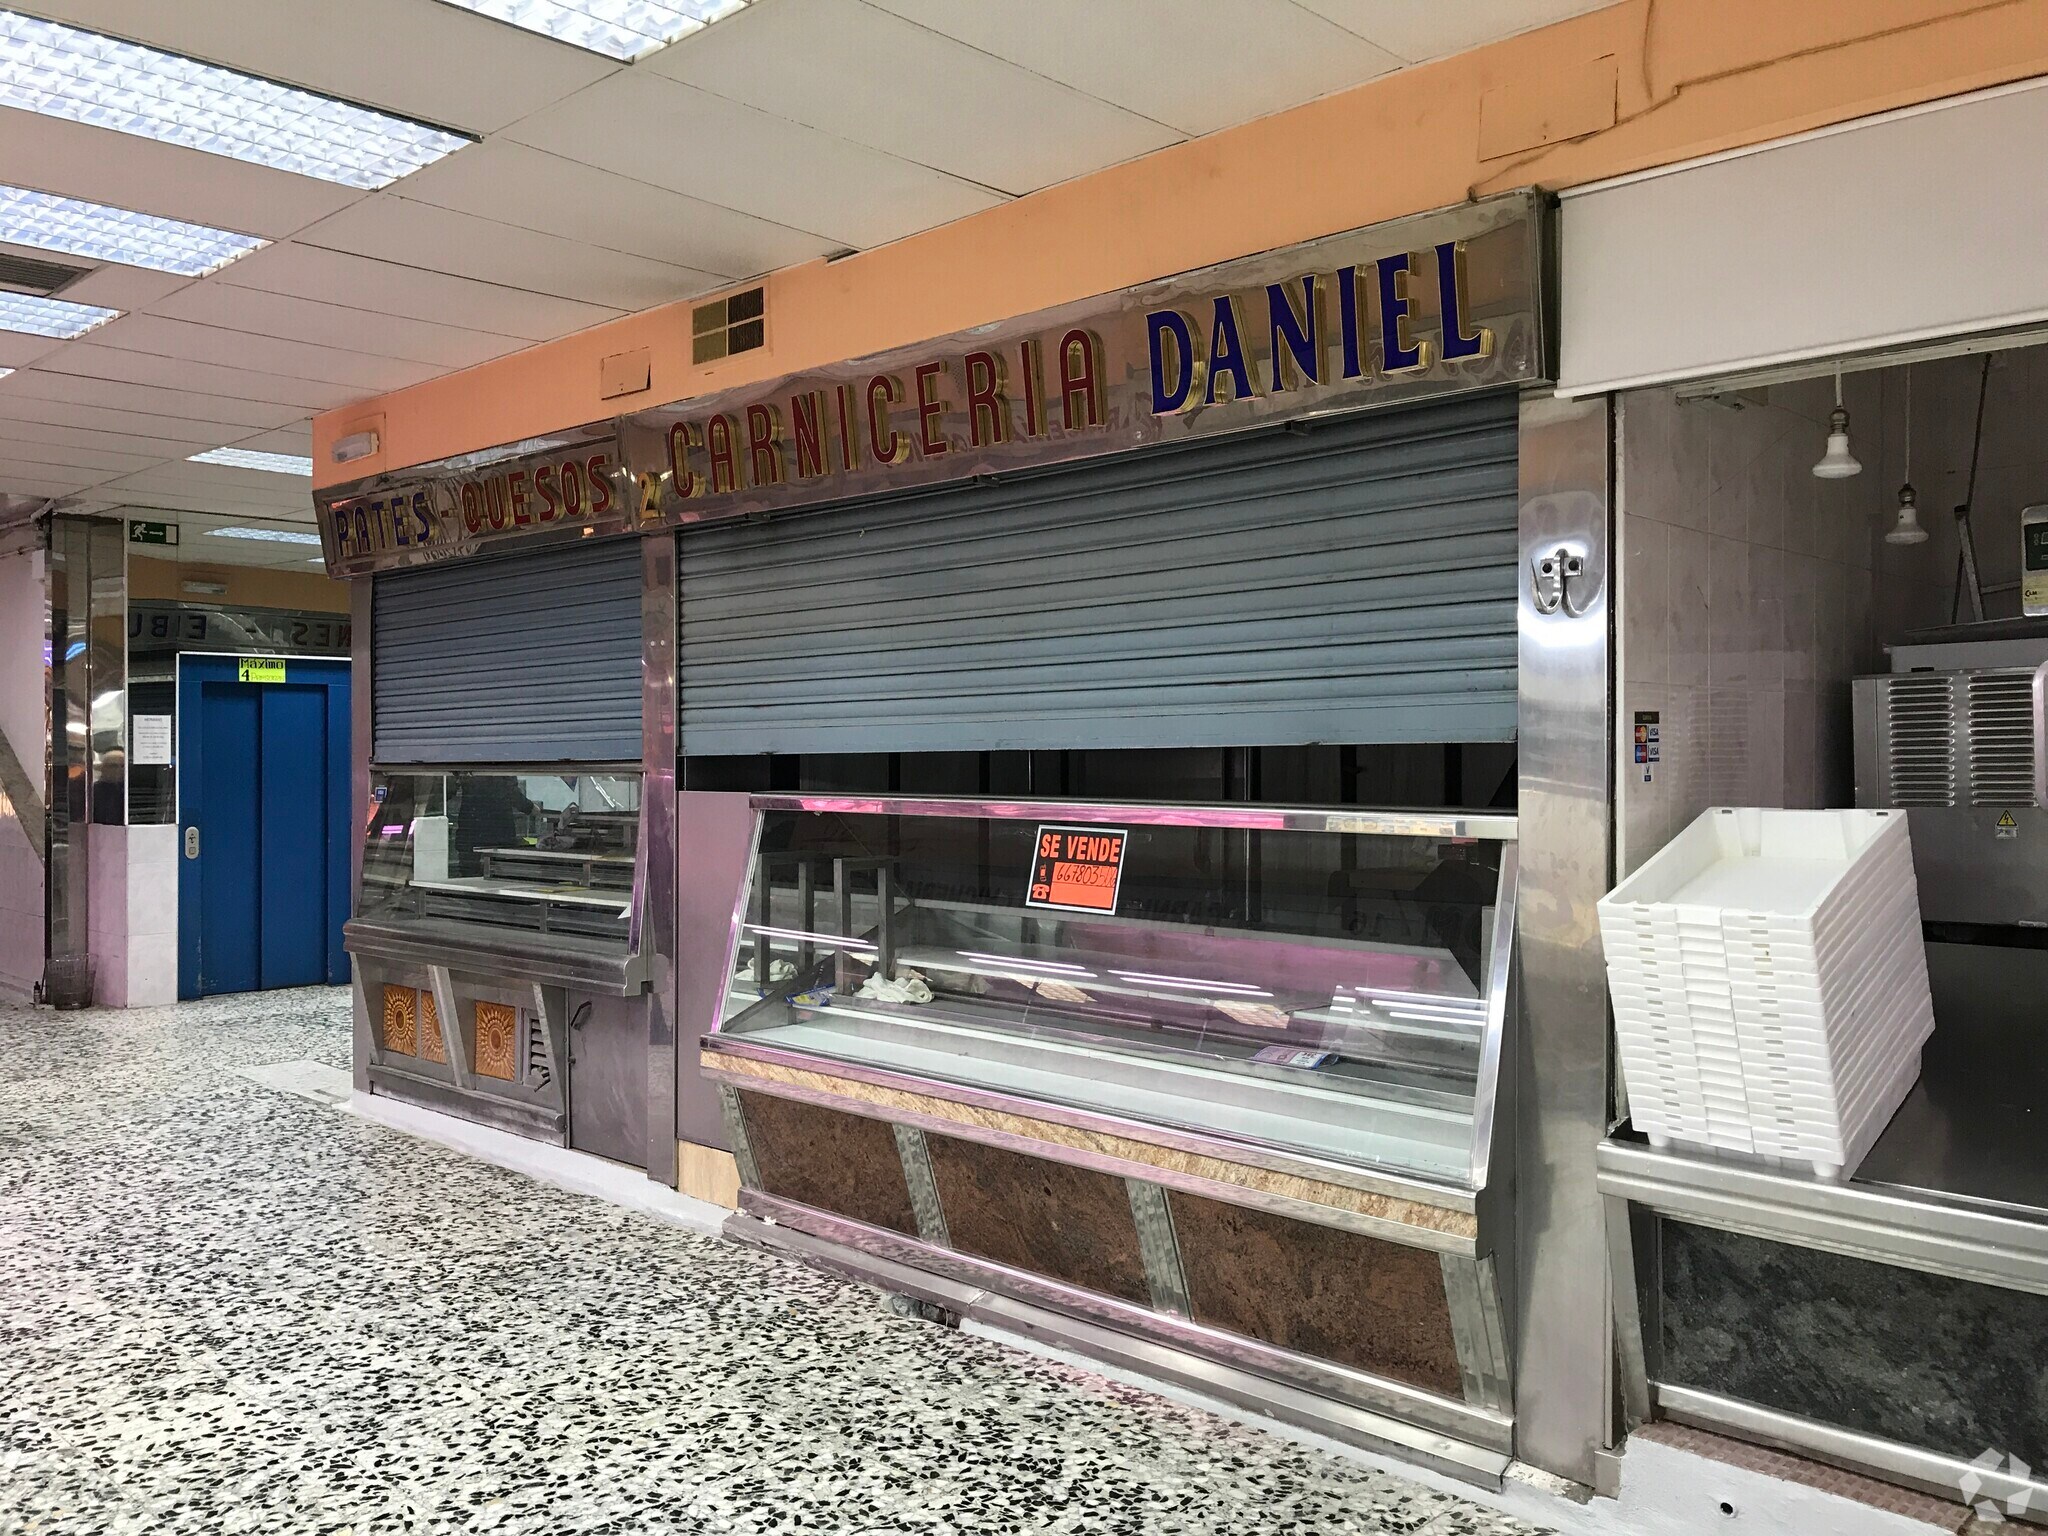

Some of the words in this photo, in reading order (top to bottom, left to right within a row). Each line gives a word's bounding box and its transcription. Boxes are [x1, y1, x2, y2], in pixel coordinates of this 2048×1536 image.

[669, 328, 1106, 498] CARNICERIA
[1145, 240, 1493, 415] DANIEL
[335, 492, 433, 557] PATES
[460, 454, 616, 534] QUESOS
[241, 669, 250, 681] 4
[1040, 833, 1061, 858] SE
[1067, 835, 1121, 862] VENDE
